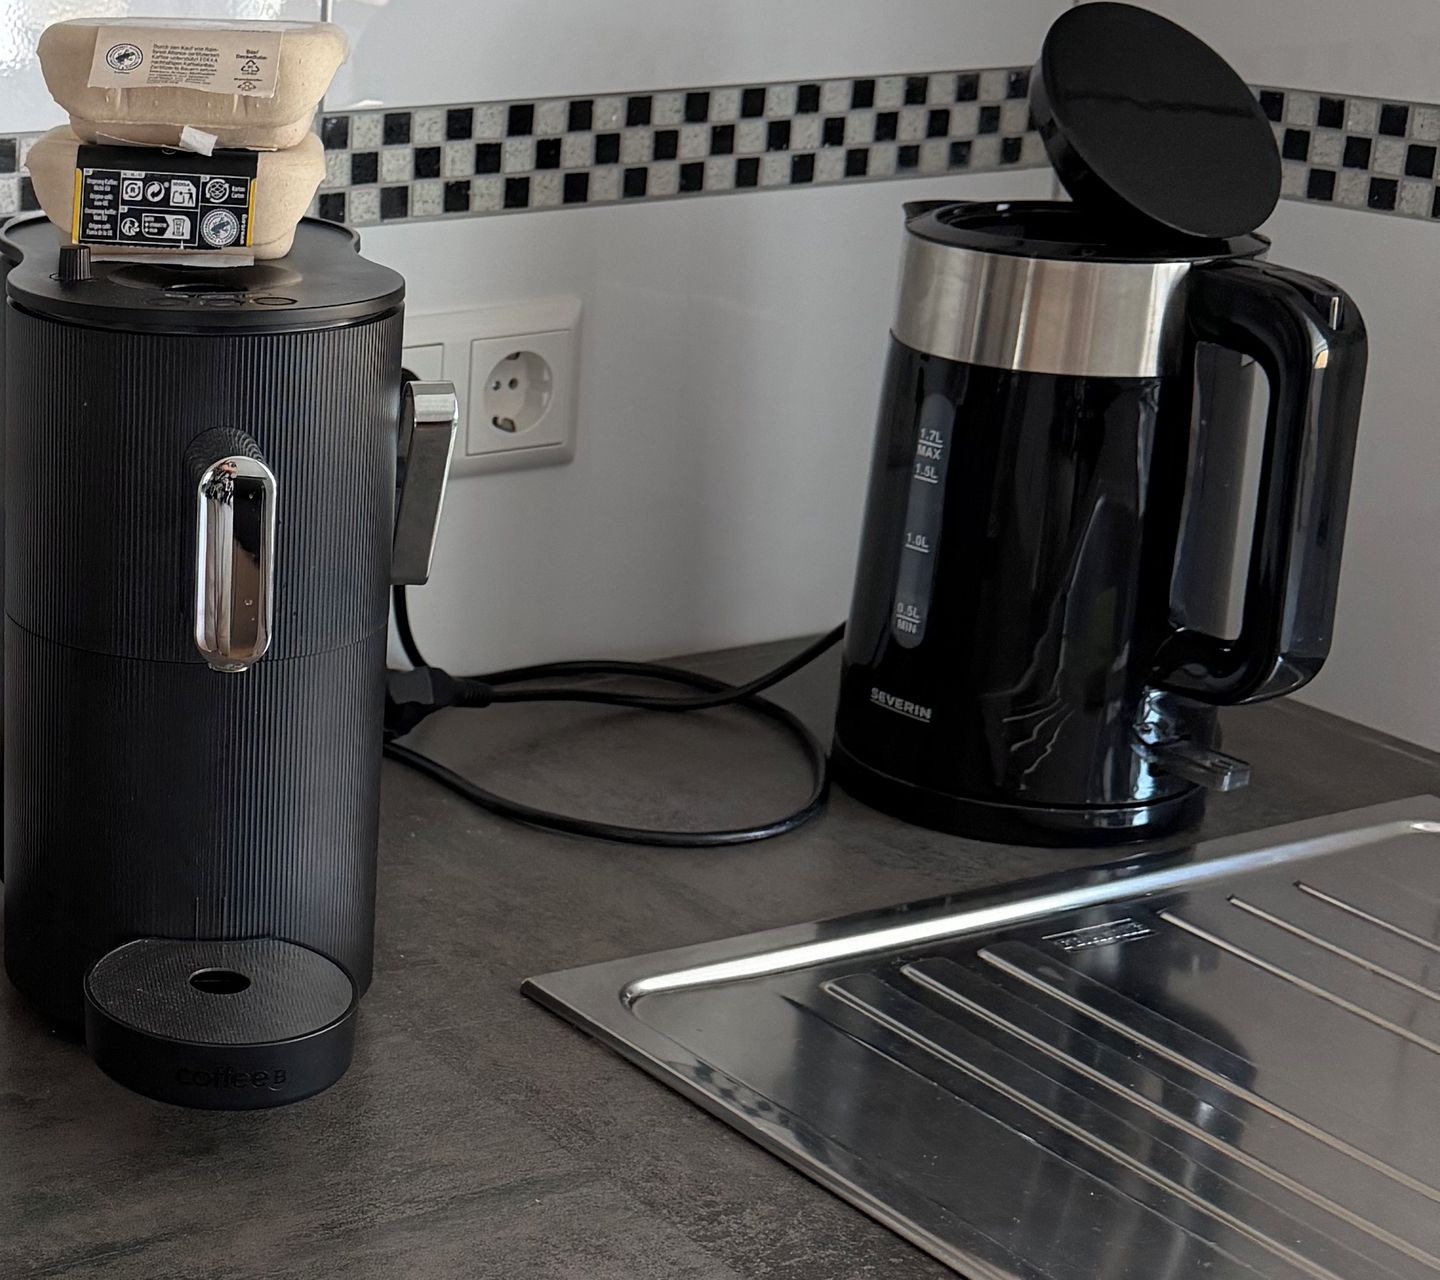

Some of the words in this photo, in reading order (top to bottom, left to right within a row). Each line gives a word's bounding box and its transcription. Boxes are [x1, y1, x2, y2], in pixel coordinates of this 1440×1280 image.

[920, 428, 943, 442] 1.7L
[917, 444, 941, 460] MAX
[871, 687, 932, 719] SEVERIN
